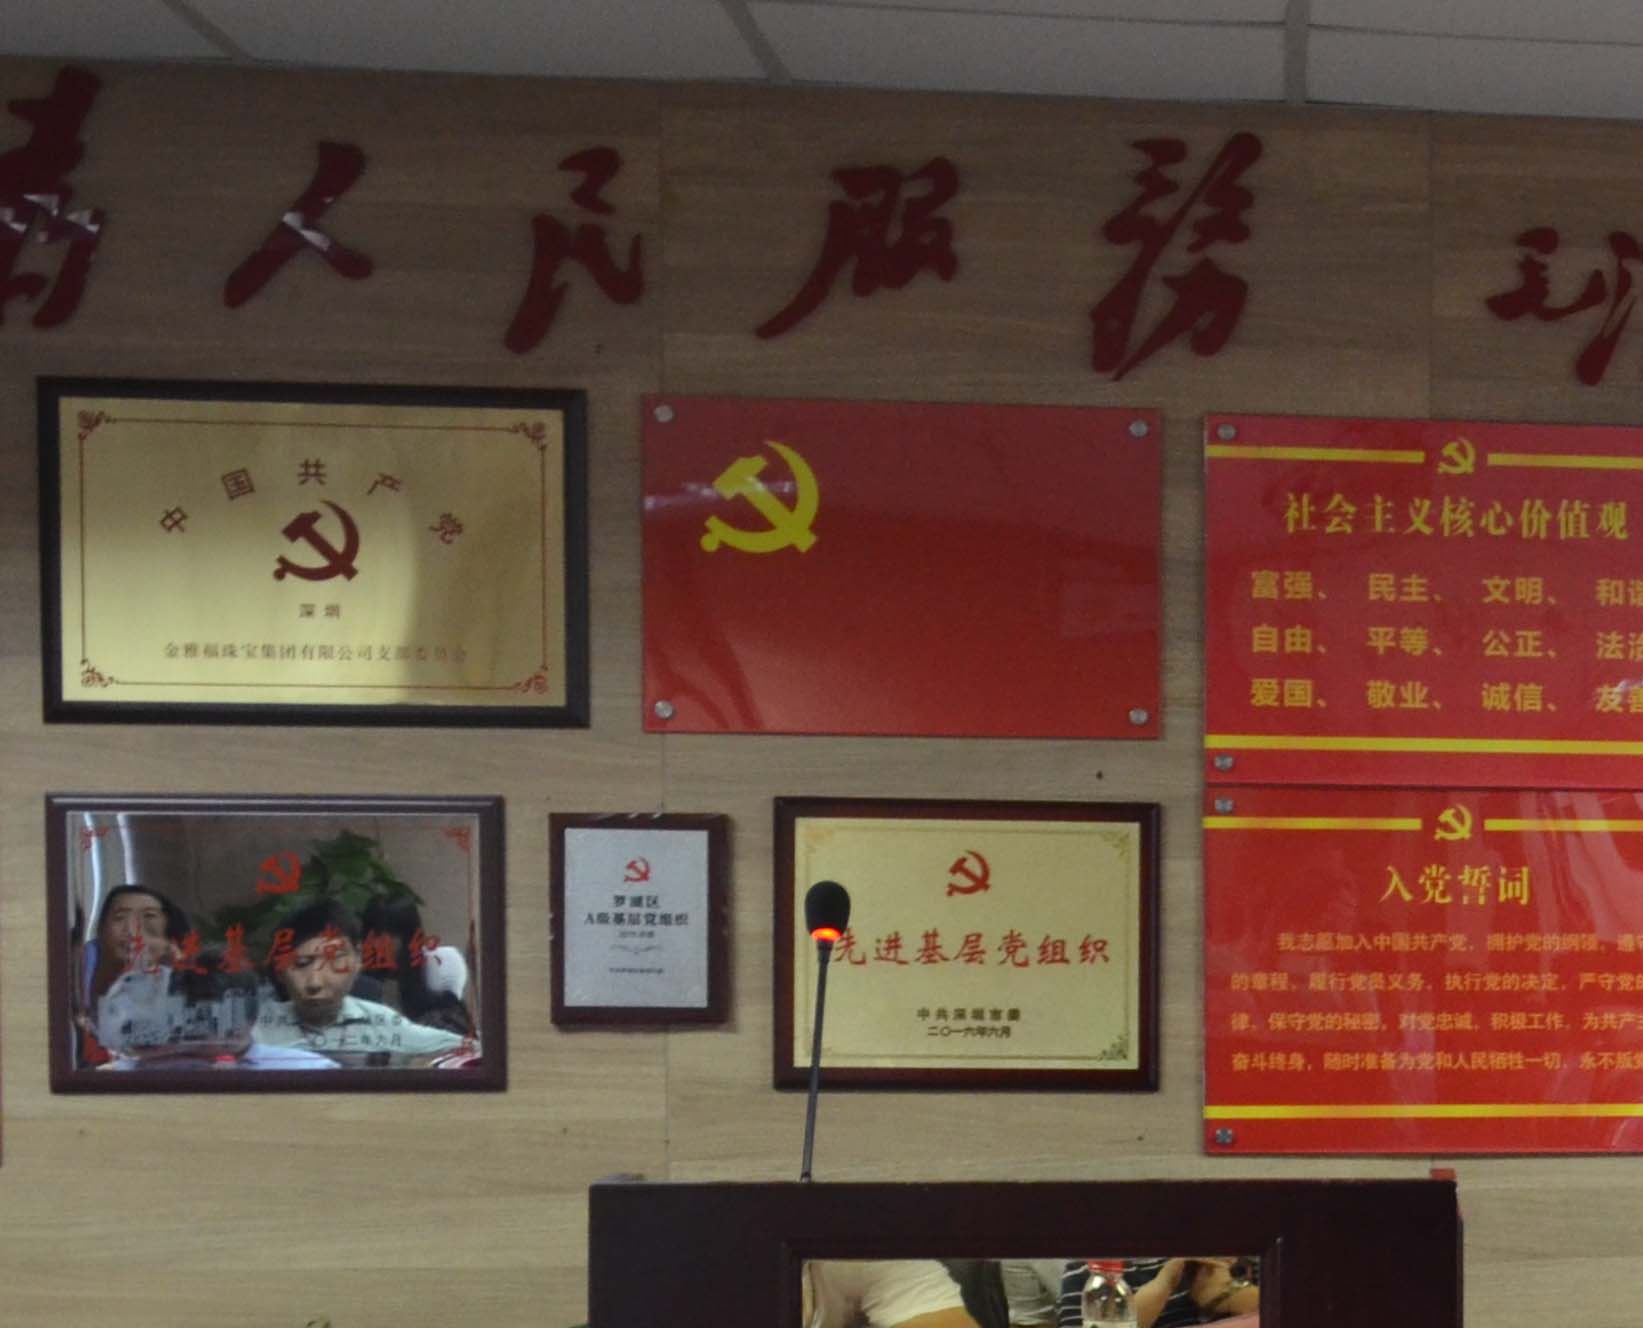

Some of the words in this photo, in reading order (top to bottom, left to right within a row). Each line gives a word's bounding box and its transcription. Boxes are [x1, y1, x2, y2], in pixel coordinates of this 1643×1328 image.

[159, 458, 465, 545] 中国共产党
[1284, 494, 1631, 541] 社会主义核心价值观
[1379, 864, 1531, 906] 入党誓词
[833, 927, 1111, 968] 先进基层党组织
